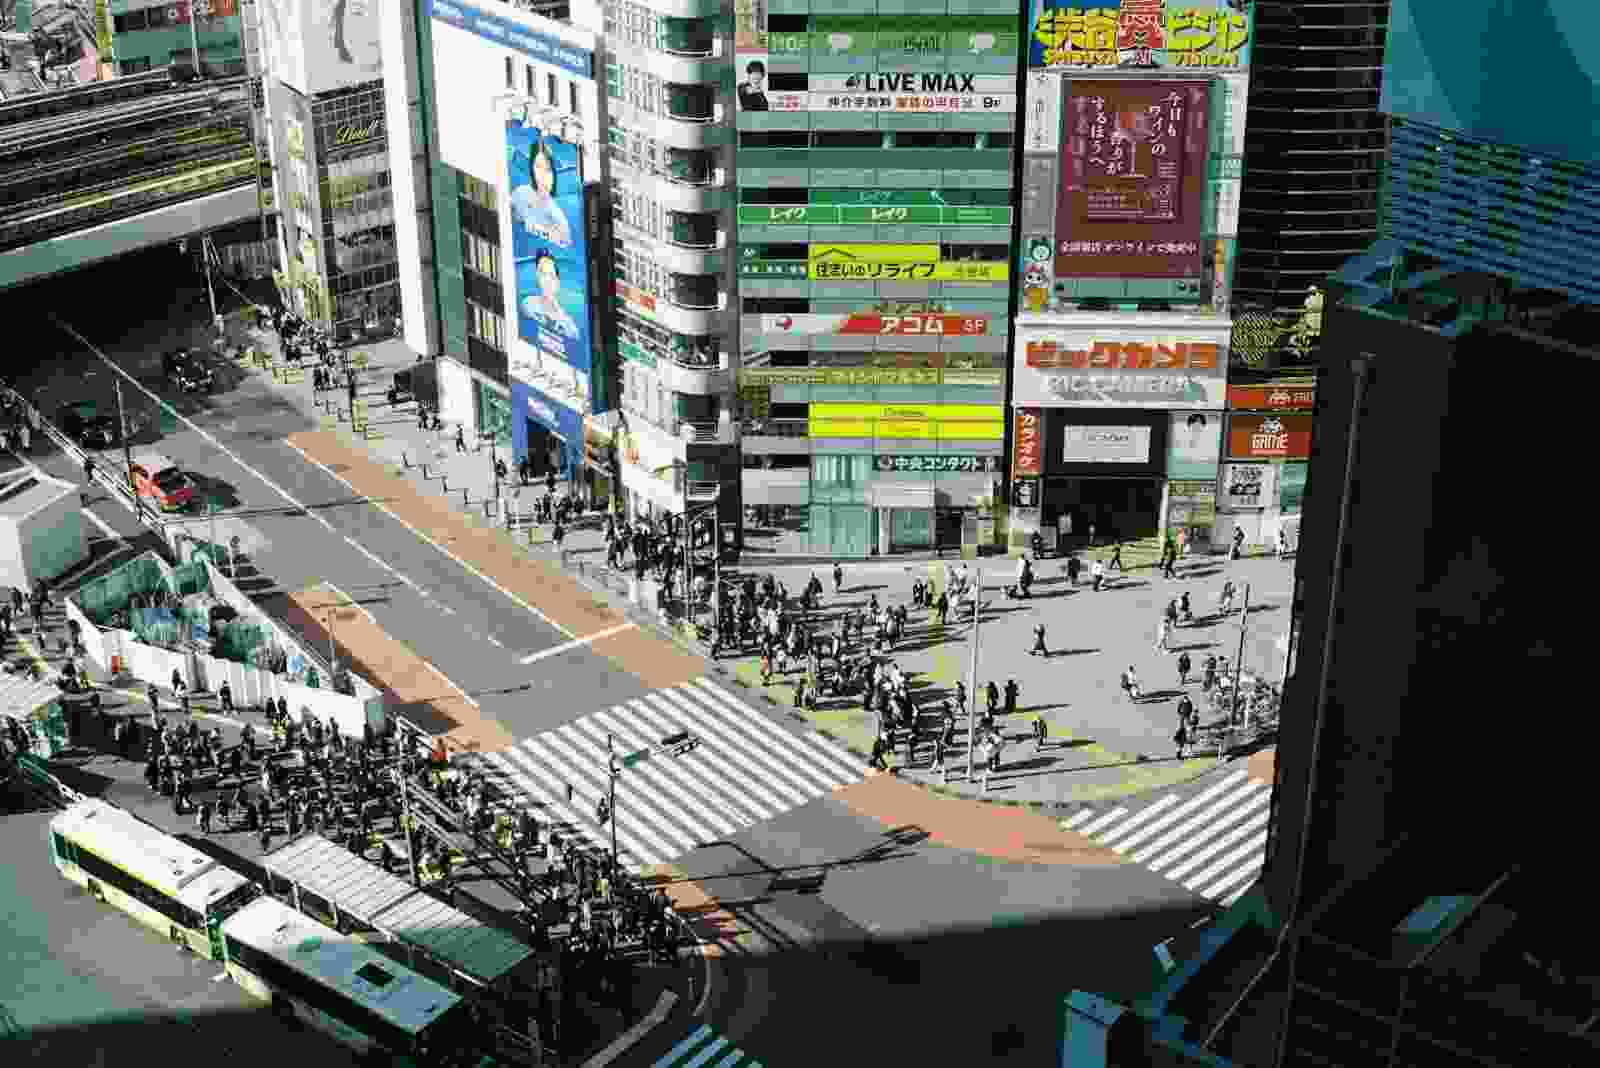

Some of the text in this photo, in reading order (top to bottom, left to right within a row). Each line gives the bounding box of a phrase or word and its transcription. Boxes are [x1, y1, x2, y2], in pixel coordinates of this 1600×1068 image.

[866, 71, 976, 93] LiVE MAX
[879, 316, 944, 334] アコム
